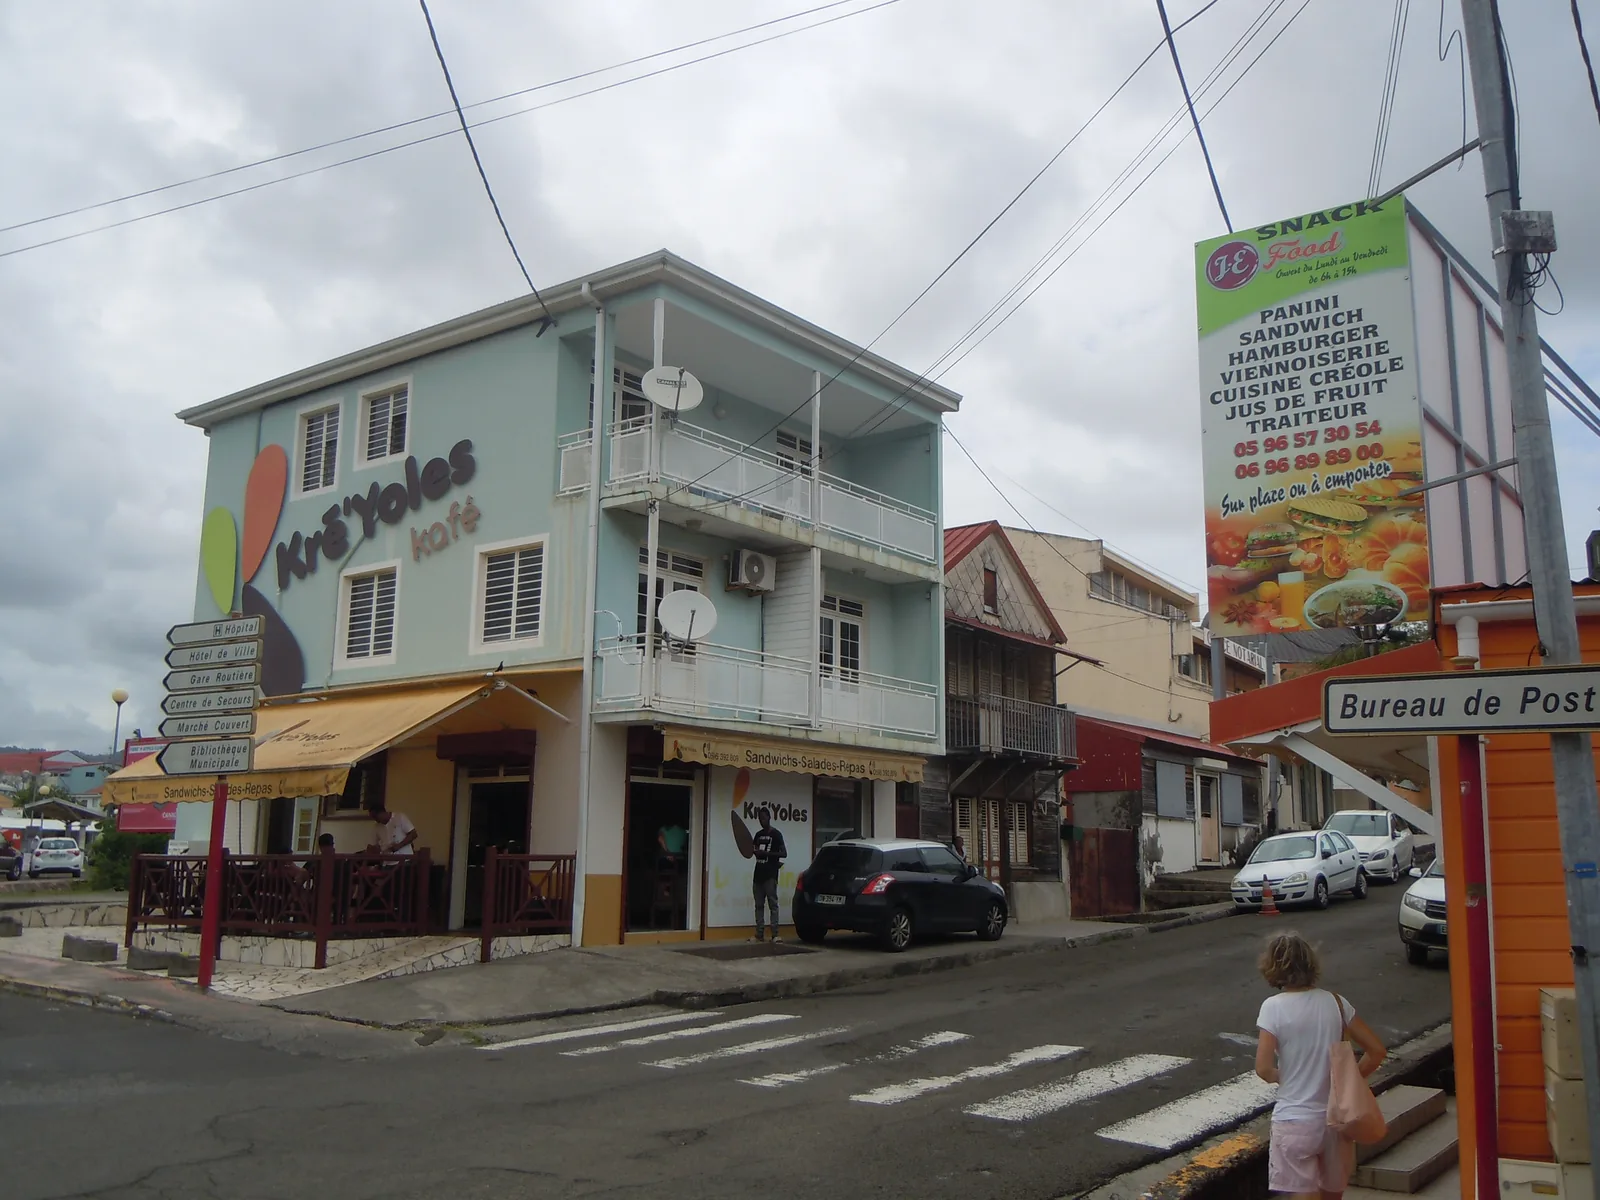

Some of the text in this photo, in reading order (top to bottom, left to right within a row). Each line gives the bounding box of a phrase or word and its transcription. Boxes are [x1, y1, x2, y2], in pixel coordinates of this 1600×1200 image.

[1255, 200, 1384, 241] SNACK
[1263, 231, 1343, 270] Food
[1276, 268, 1301, 279] Ouvert
[1315, 257, 1338, 271] Lundi
[1352, 245, 1388, 261] Vendredi
[1308, 275, 1318, 284] de
[1320, 271, 1331, 281] 6h
[1342, 266, 1357, 277] 15h
[1260, 294, 1339, 324] PANINI
[1239, 308, 1364, 346] SANDWICH
[1228, 324, 1379, 366] HAMBURGER
[1220, 340, 1390, 385] VIENNOISERIE
[1209, 356, 1404, 405] CUISINE CRÉOLE
[1225, 378, 1388, 420] JUS DE FRUIT
[1246, 401, 1368, 434] TRAITEUR
[1234, 419, 1382, 458] 05 96 57 30 54
[1235, 442, 1384, 480] 06 96 89 89 00
[1221, 460, 1393, 518] Sur place ou à emporter
[410, 495, 482, 562] kafé
[224, 621, 258, 635] Hôpital
[189, 644, 255, 661] Hôtel de Ville
[1232, 643, 1264, 670] NOTARIAL
[190, 670, 253, 685] Gare Routière
[170, 695, 252, 709] Centre de Secours
[1339, 693, 1445, 719] Bureau
[1463, 688, 1501, 716] de
[177, 719, 249, 733] Marché Couvert
[189, 757, 240, 770] Municipale
[190, 743, 248, 757] Bibliothèque
[164, 782, 273, 799] Sandwichs-Sdes-Repas
